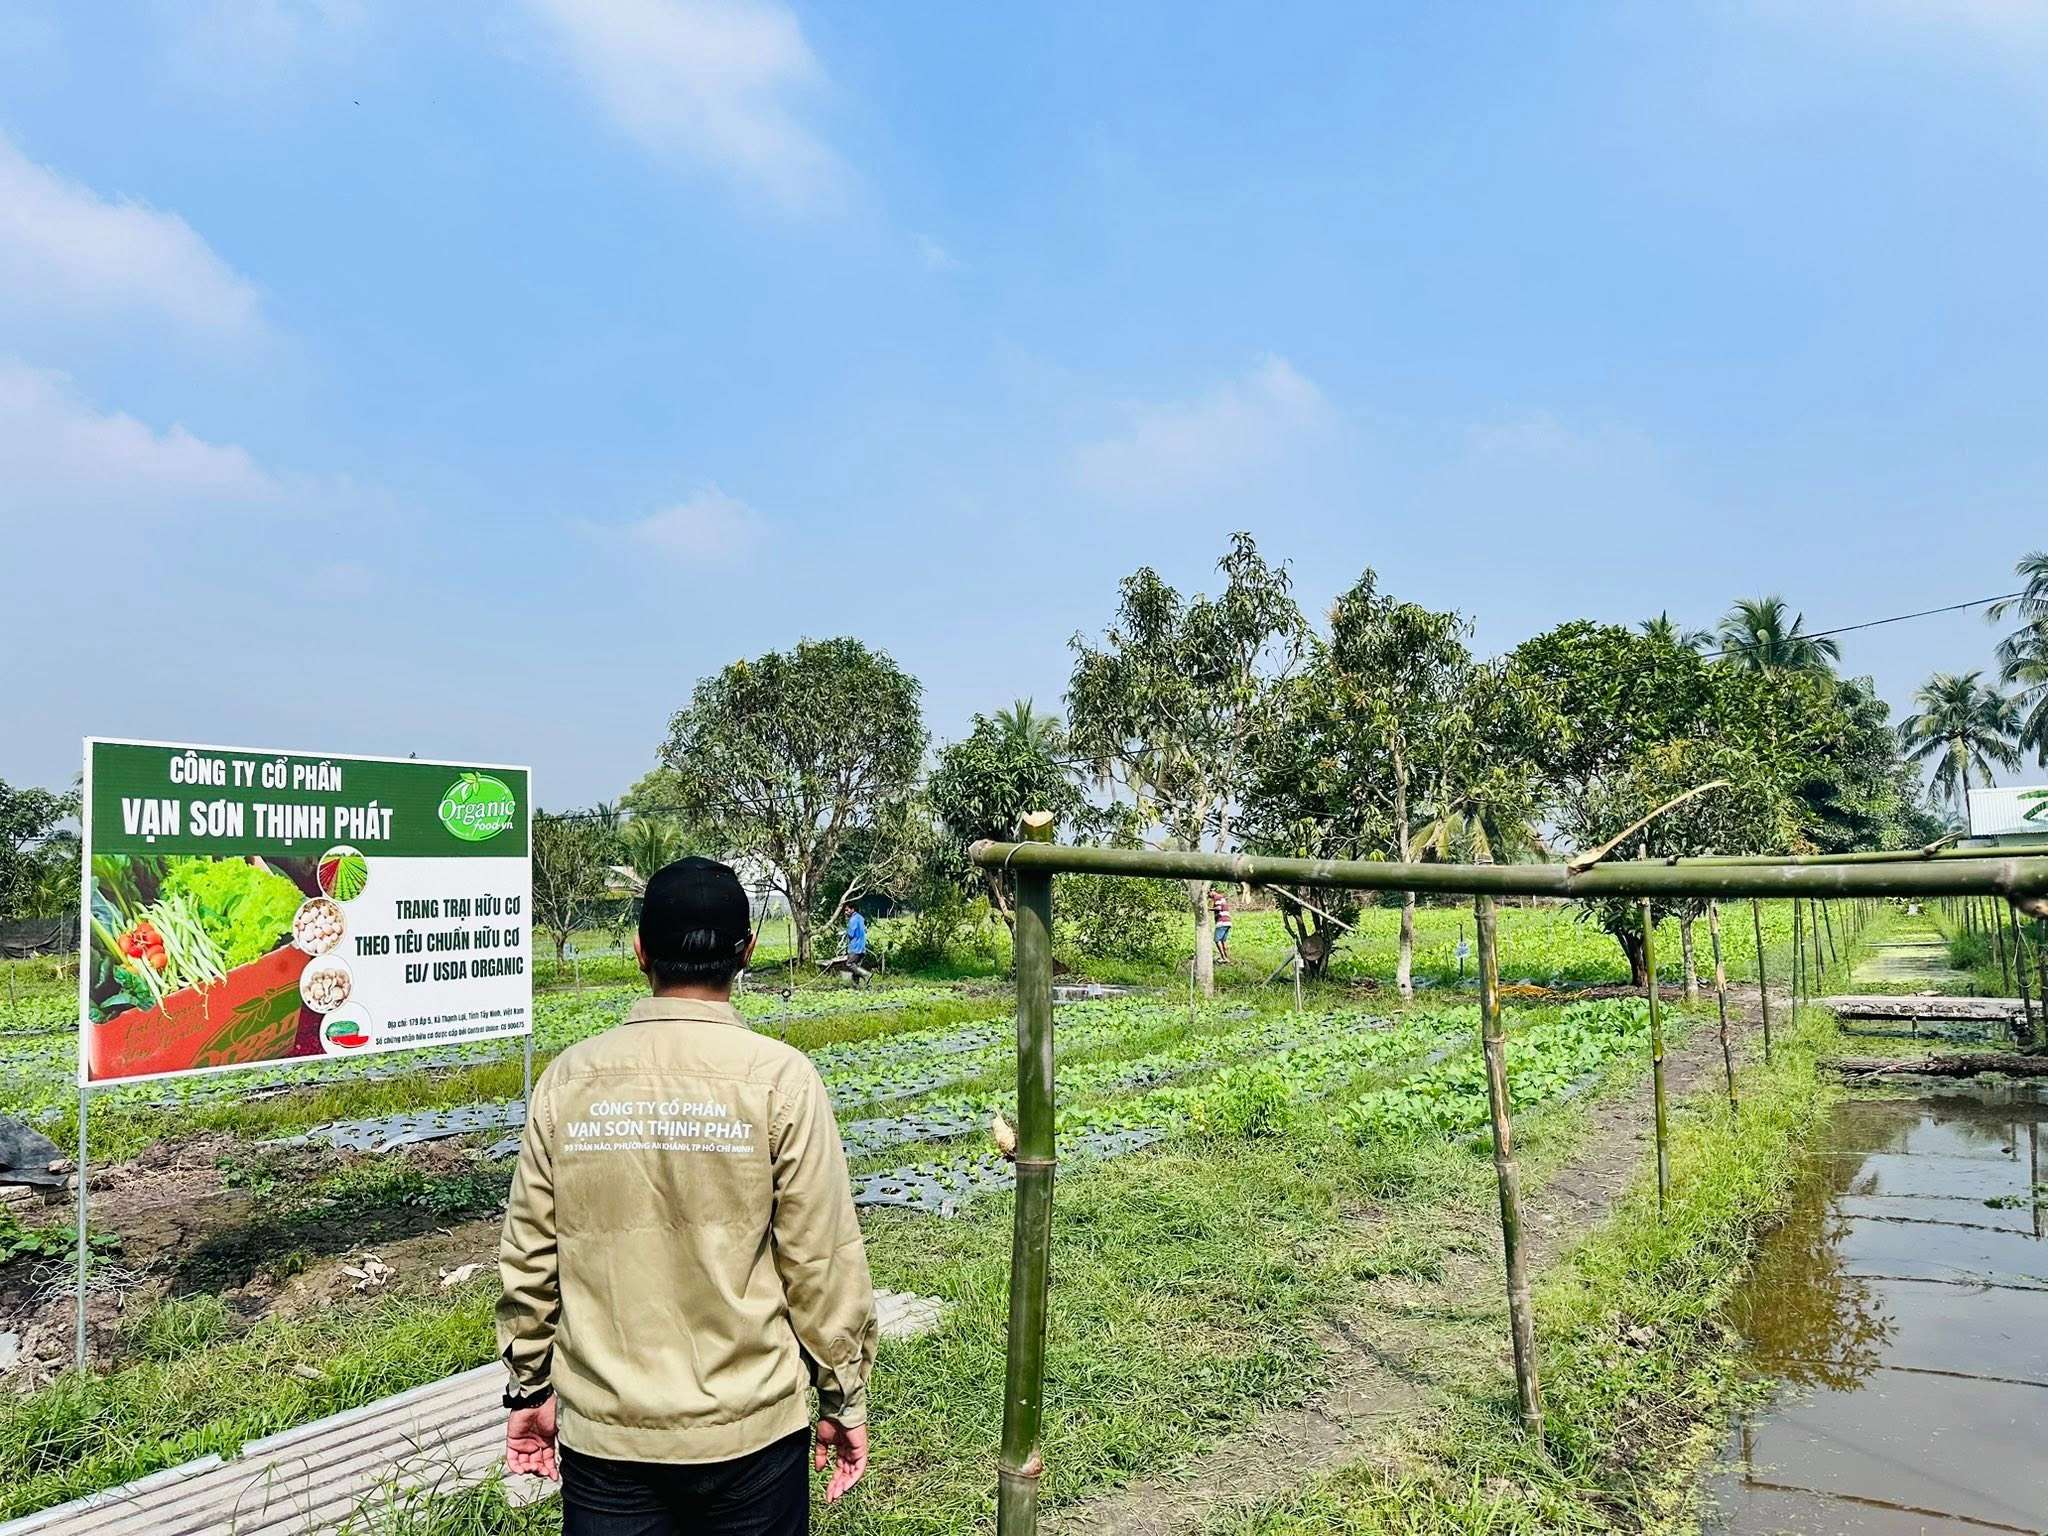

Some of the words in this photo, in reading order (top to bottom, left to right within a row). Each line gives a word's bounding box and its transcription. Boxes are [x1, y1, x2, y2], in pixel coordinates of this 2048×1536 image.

[170, 750, 226, 786] CÔNG
[232, 760, 255, 787] TY
[261, 756, 289, 789] CỔ
[293, 760, 342, 791] PHẦN
[121, 797, 181, 843] VẠN
[189, 799, 244, 837] SƠN
[252, 803, 326, 845] THỊNH
[334, 800, 394, 840] PHÁT
[438, 796, 516, 825] Organic
[396, 899, 439, 919] TRANG
[443, 899, 471, 921] TRẠI
[475, 893, 501, 916] HỮU
[505, 896, 521, 915] CƠ
[355, 935, 390, 956] THEO
[395, 929, 422, 954] TIÊU
[427, 926, 470, 952] CHUẨN
[474, 925, 500, 949] HỮU
[504, 927, 520, 947] CƠ
[405, 963, 429, 984] EU/
[433, 960, 467, 981] USDA
[471, 956, 524, 978] ORGANIC
[589, 1099, 633, 1116] CÔNG
[636, 1101, 656, 1116] TY
[567, 1120, 601, 1142] VẠN
[604, 1118, 643, 1137] SƠN
[647, 1120, 701, 1141] THỊNH
[704, 1120, 754, 1140] PHÁT
